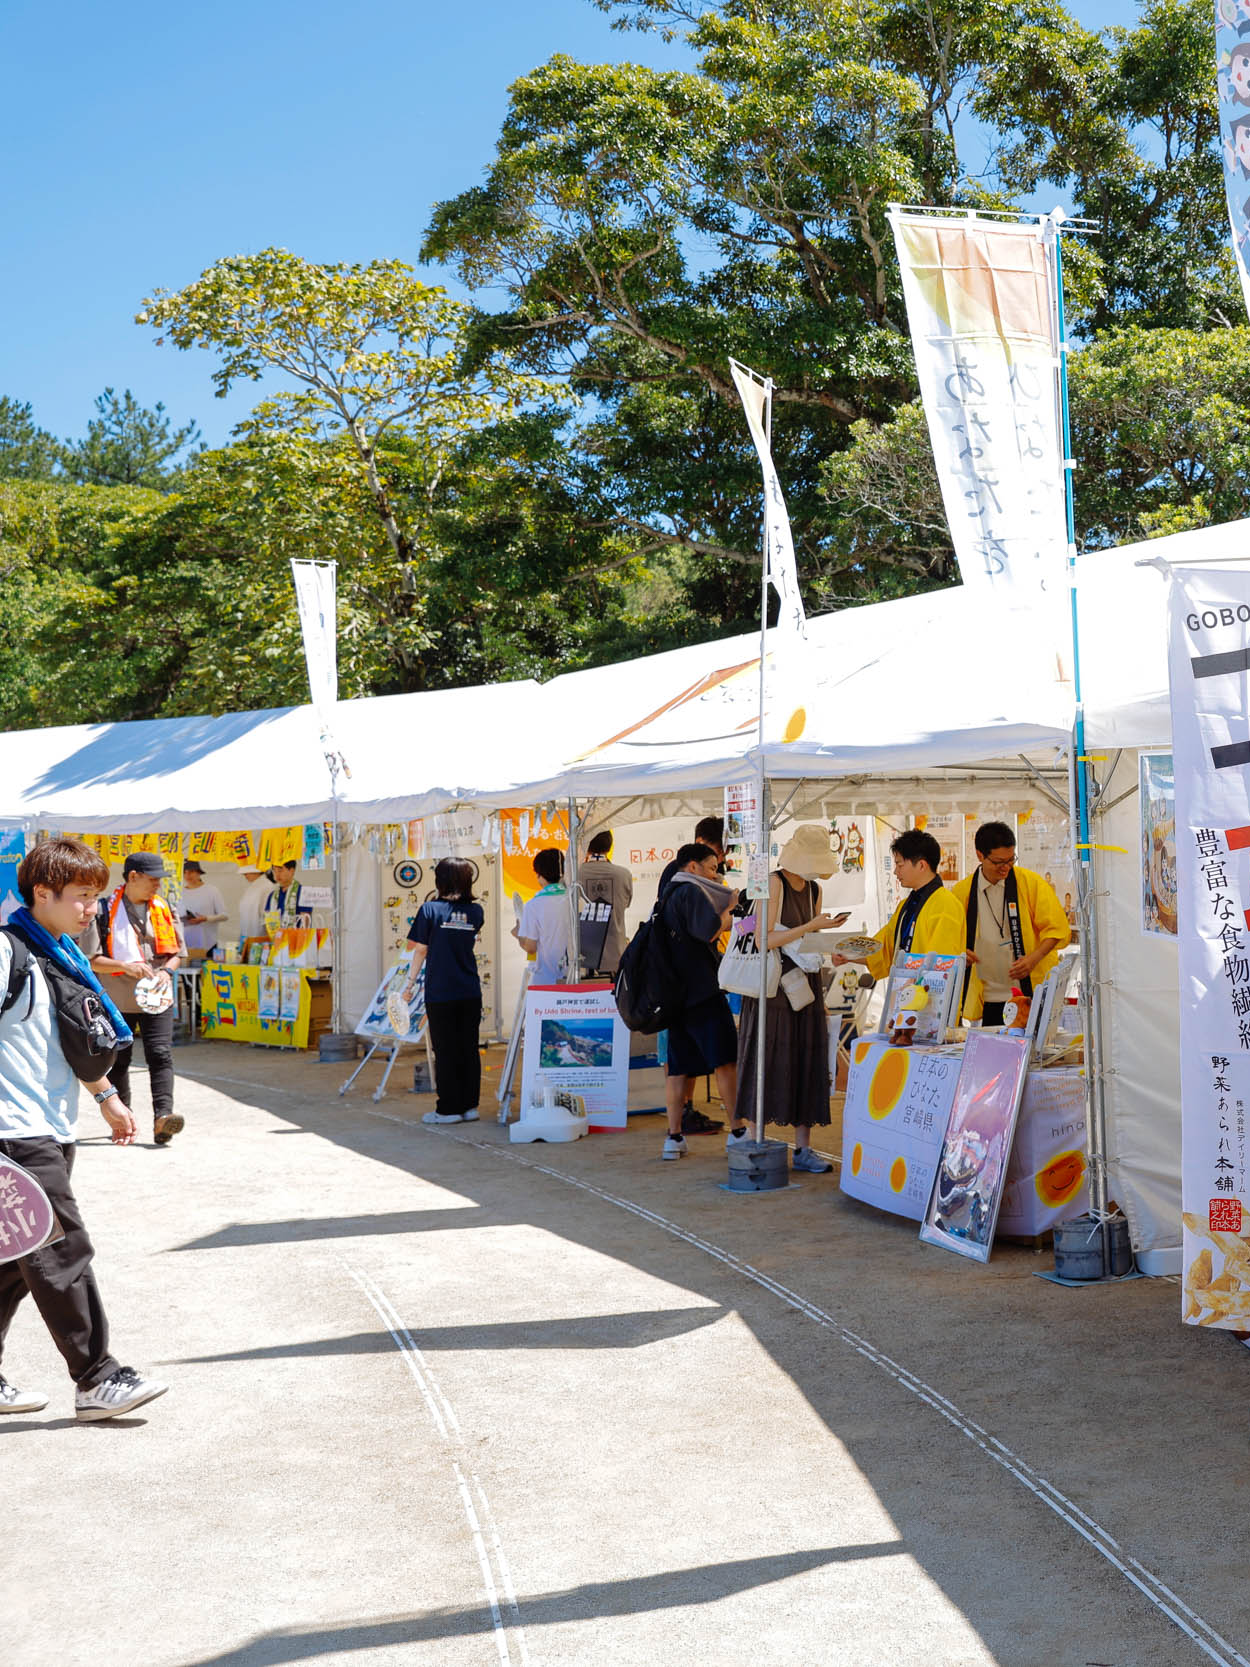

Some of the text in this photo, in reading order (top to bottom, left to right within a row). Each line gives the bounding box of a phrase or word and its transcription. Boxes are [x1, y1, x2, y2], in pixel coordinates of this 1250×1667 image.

[918, 1055, 949, 1080] 日本の
[910, 1081, 940, 1108] ひなた
[903, 1104, 934, 1132] 宮崎県
[1211, 1056, 1235, 1193] 野菜あられ本舗
